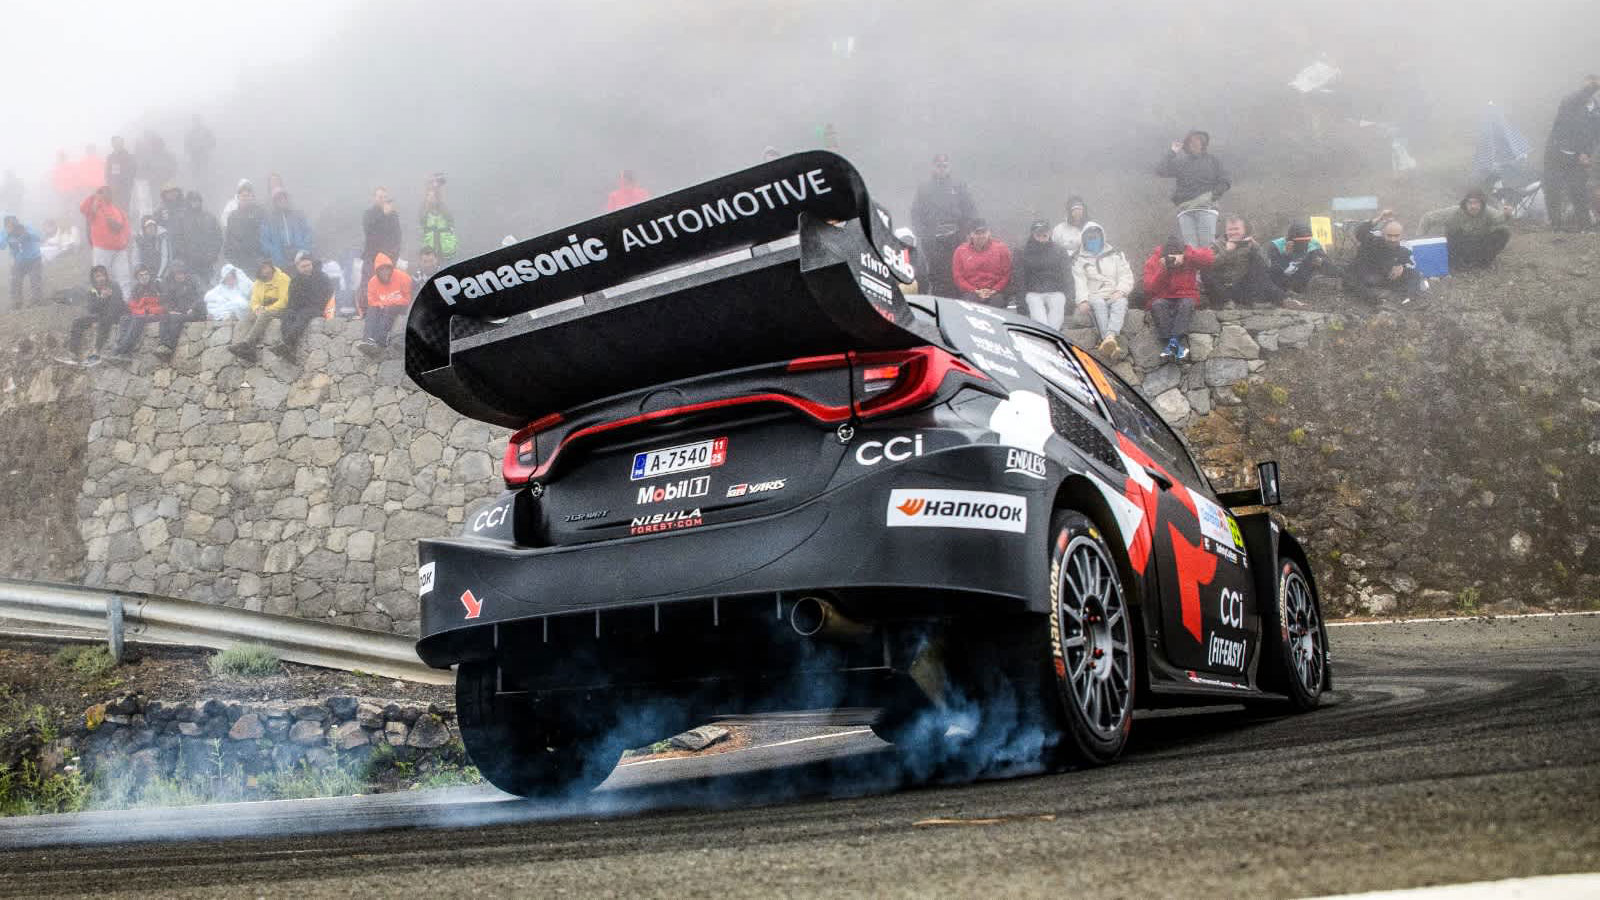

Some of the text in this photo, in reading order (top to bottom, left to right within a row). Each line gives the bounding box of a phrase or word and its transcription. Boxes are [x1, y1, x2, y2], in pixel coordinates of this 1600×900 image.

[435, 168, 832, 306] Panasonic AUTOMOTIVE
[650, 446, 708, 472] A-7540
[1006, 448, 1047, 476] ENDLESS
[636, 480, 688, 505] Mobil
[631, 508, 702, 526] NISULA
